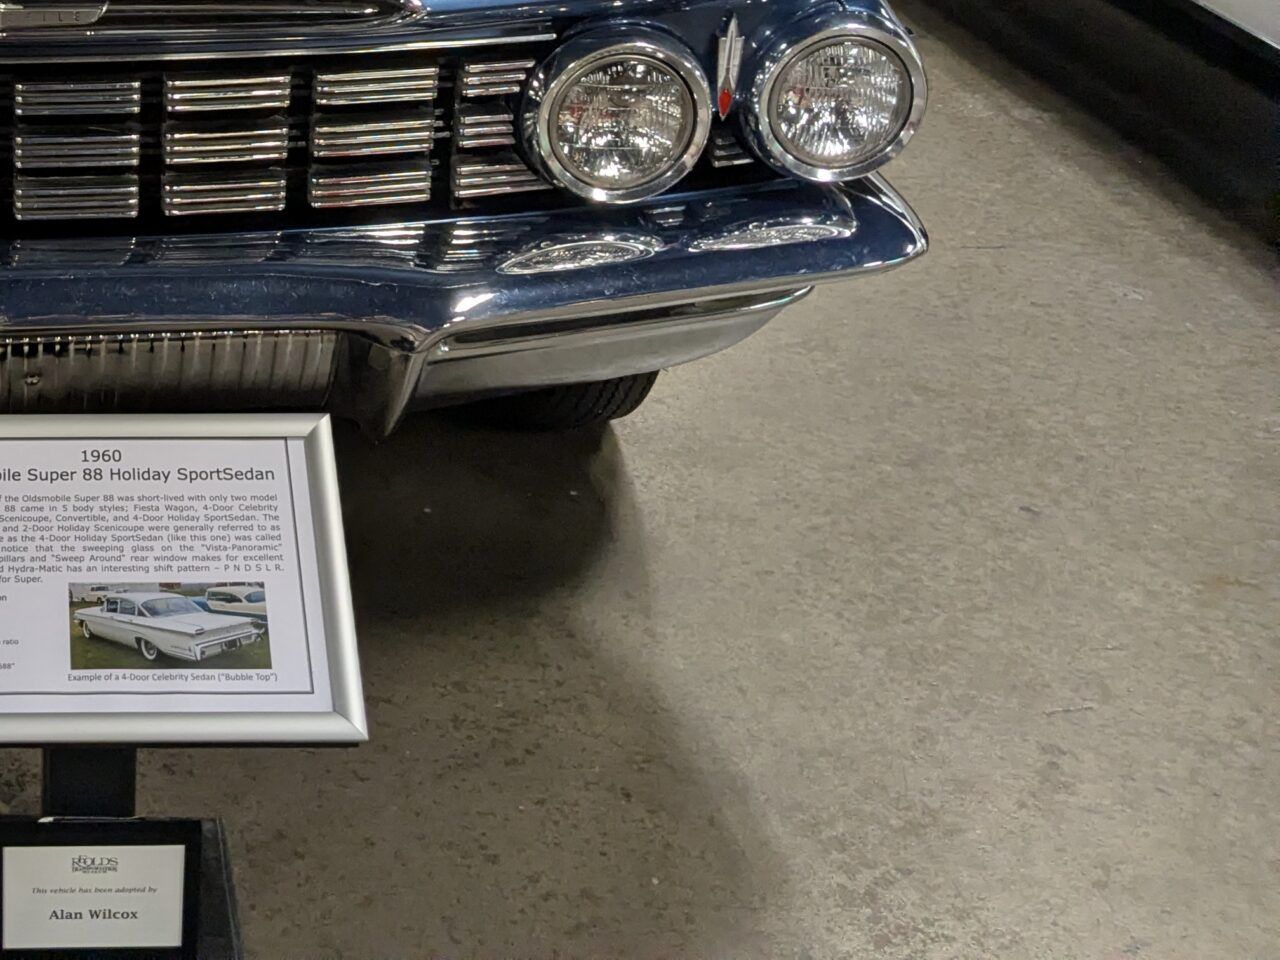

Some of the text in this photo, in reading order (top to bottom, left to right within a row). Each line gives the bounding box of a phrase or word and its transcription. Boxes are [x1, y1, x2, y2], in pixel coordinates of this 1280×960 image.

[82, 449, 122, 463] 1960
[27, 468, 77, 484] Super
[82, 468, 103, 481] 88
[110, 468, 171, 484] Holiday
[177, 468, 275, 484] SportSedan
[74, 495, 100, 504] Super
[209, 494, 228, 504] only
[72, 504, 94, 514] body
[99, 504, 128, 514] styles;
[164, 504, 197, 513] Wagon,
[238, 504, 278, 513] Celebrity
[55, 514, 109, 524] Convertible,
[167, 514, 200, 523] Holiday
[204, 514, 259, 523] SportSedan.
[57, 524, 90, 534] Holiday
[94, 524, 144, 534] Scenicoupe
[173, 524, 214, 533] generally
[68, 673, 102, 683] Example
[103, 673, 113, 681] of
[121, 673, 150, 681] 4-Door
[152, 673, 189, 683] Celebrity
[190, 673, 216, 681] Sedan
[218, 673, 253, 683] ("Bubble
[255, 673, 278, 683] Top")
[114, 887, 146, 895] adopted
[148, 886, 157, 894] by
[49, 909, 138, 920] Alan Wilcox
